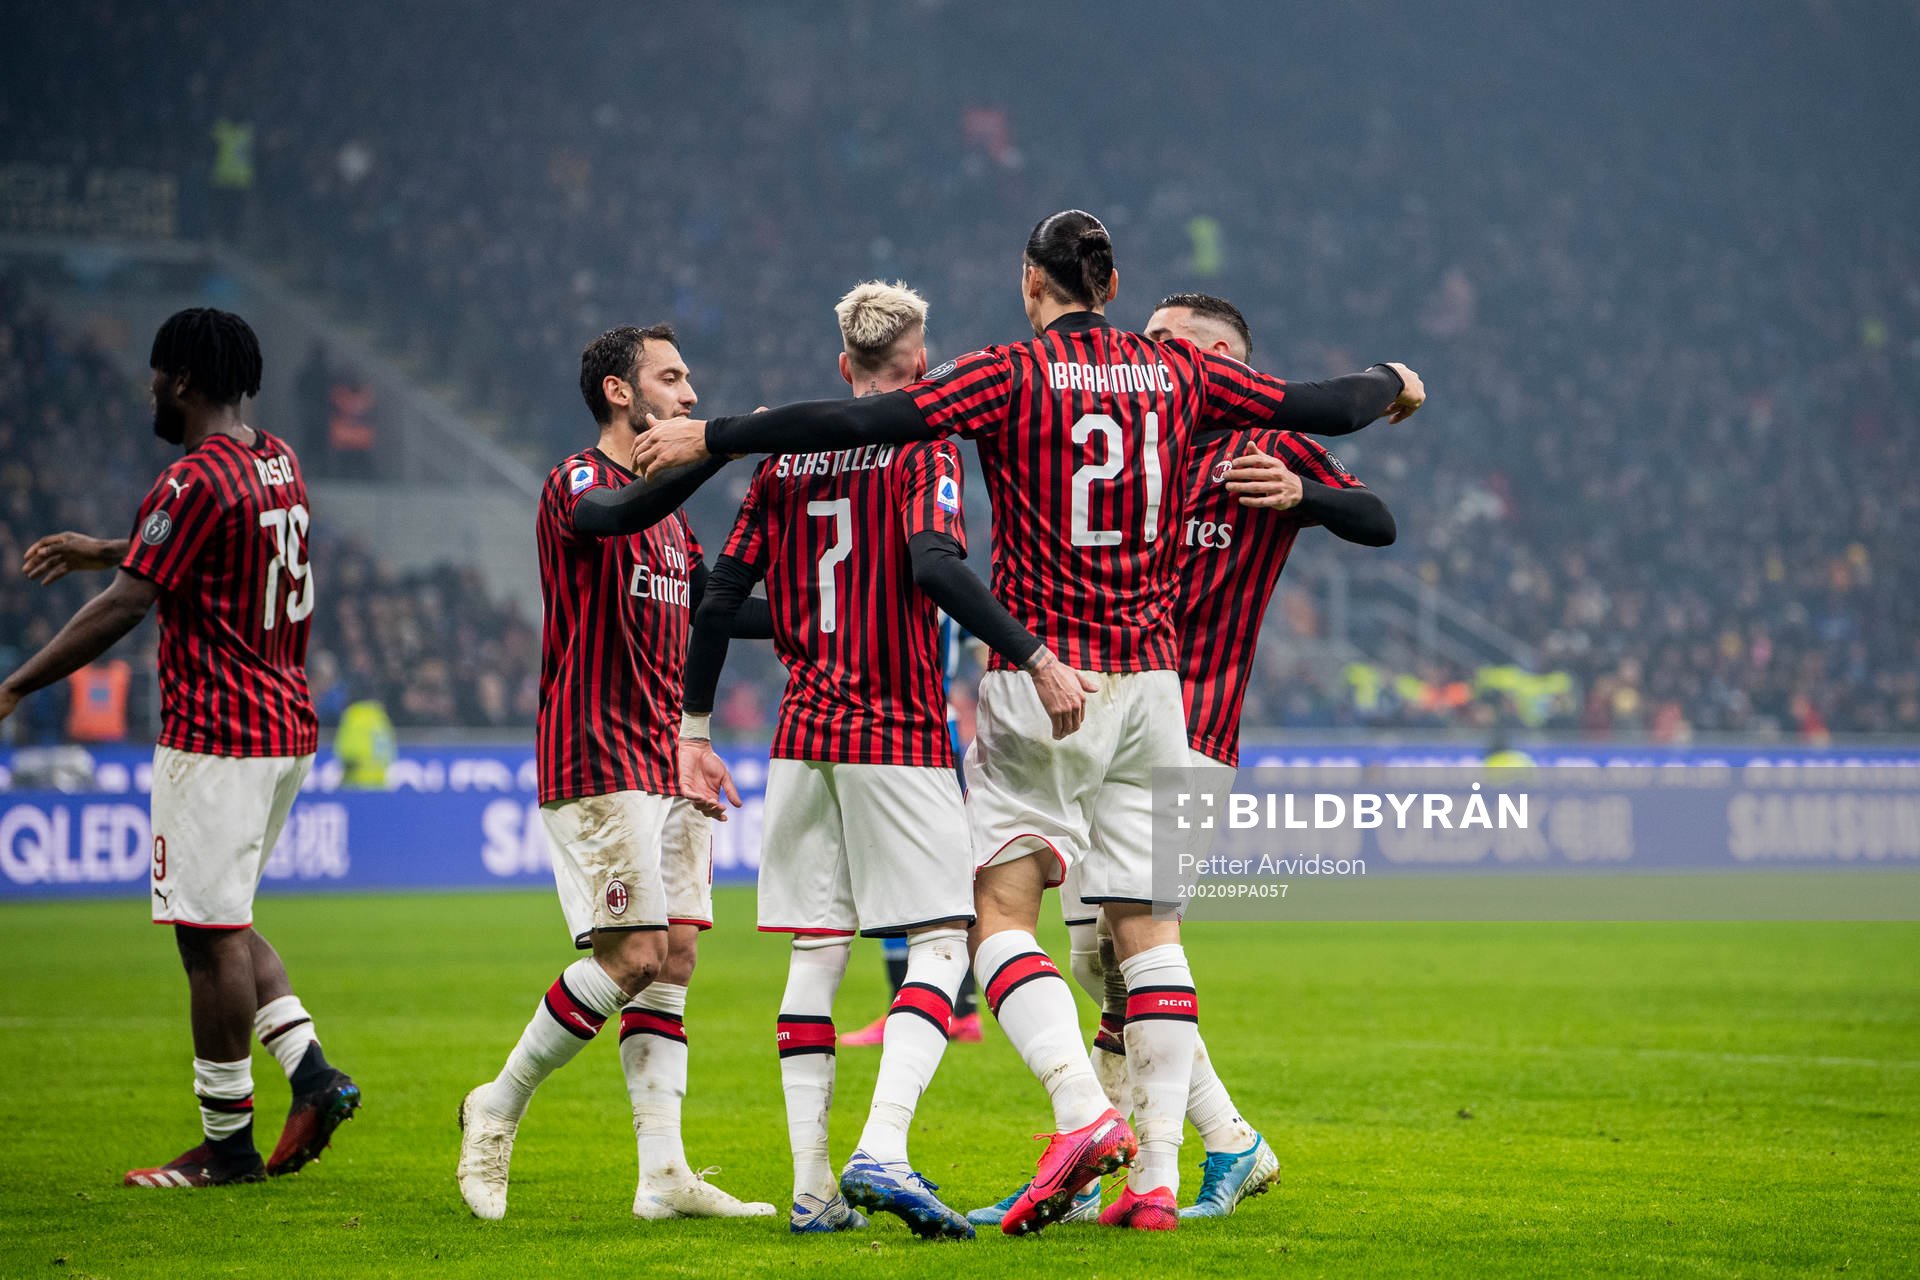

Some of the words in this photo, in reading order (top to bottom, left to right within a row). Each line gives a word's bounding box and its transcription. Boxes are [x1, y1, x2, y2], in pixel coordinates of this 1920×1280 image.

[1047, 360, 1174, 394] IBRAHIMOVIĆ
[1071, 411, 1163, 547] 21
[259, 504, 315, 631] 79
[664, 544, 686, 576] Fly
[807, 497, 853, 634] 7
[0, 803, 151, 886] QLED
